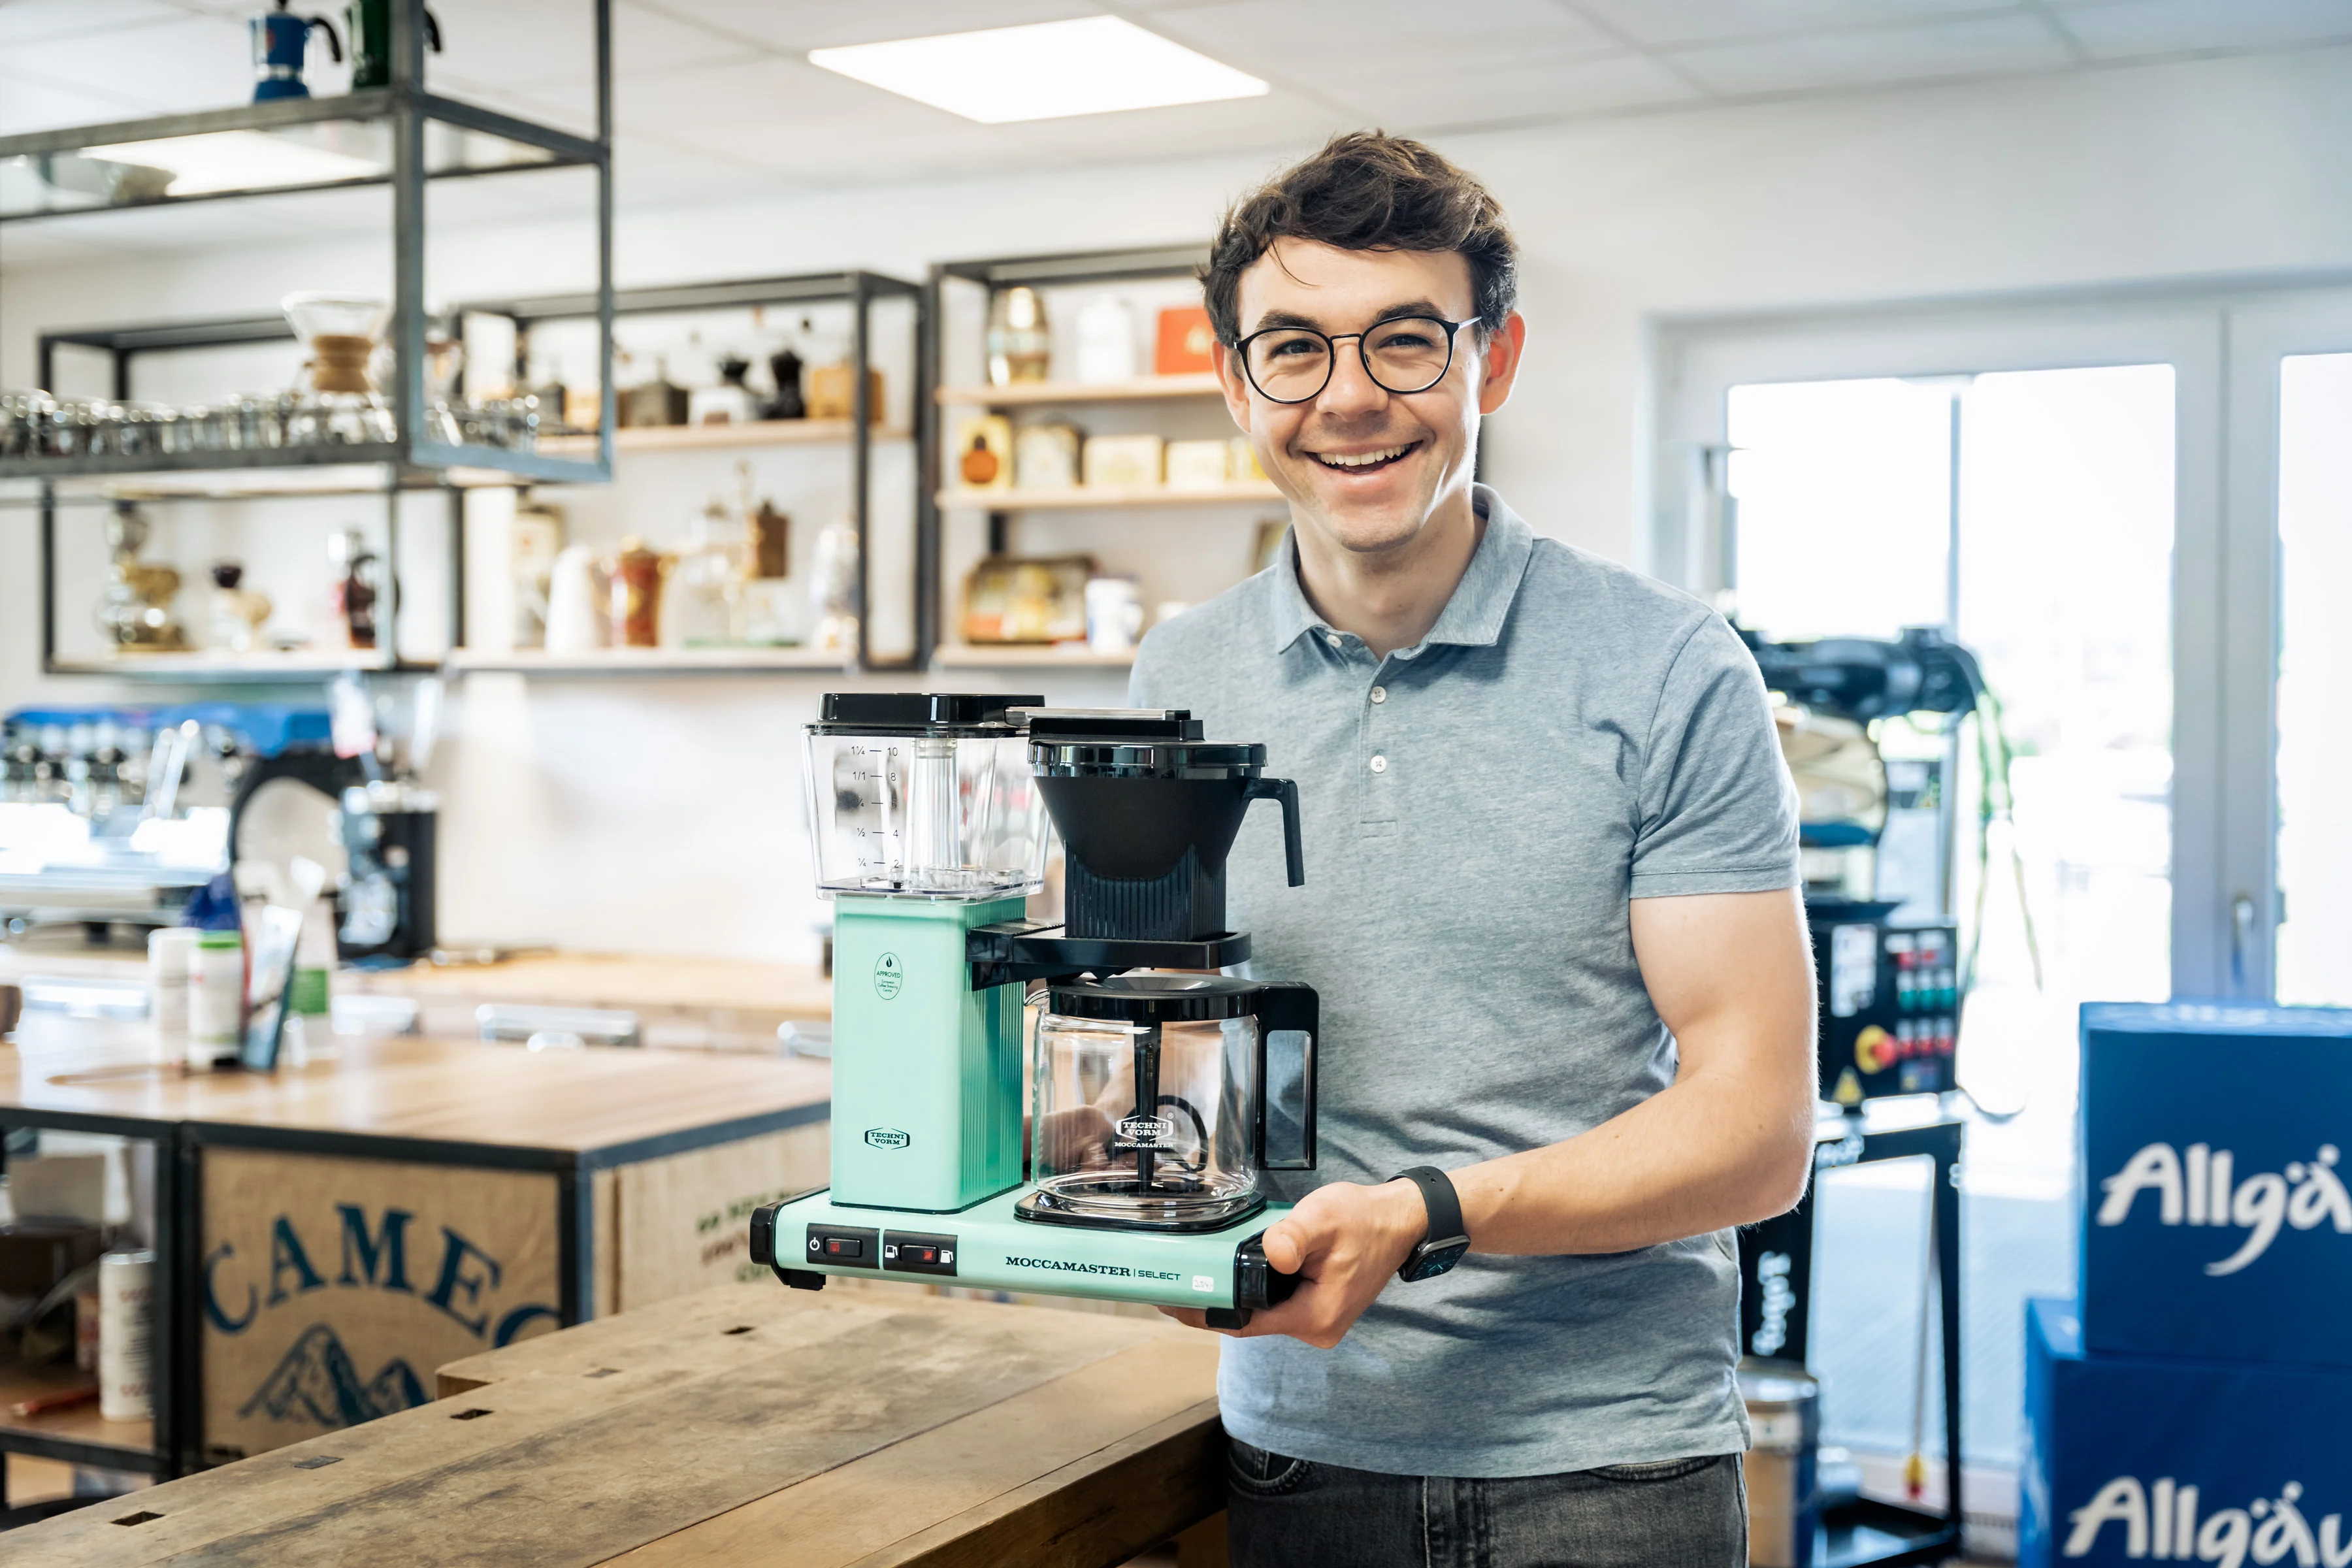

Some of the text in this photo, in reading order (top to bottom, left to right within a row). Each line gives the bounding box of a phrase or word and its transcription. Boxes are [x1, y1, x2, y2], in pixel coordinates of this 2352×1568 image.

[887, 747, 898, 757] 10
[853, 771, 896, 781] 1/1 8
[892, 829, 898, 838] 4
[894, 859, 900, 868] 2
[1005, 1256, 1181, 1281] MOCCAMASTER SELECT
